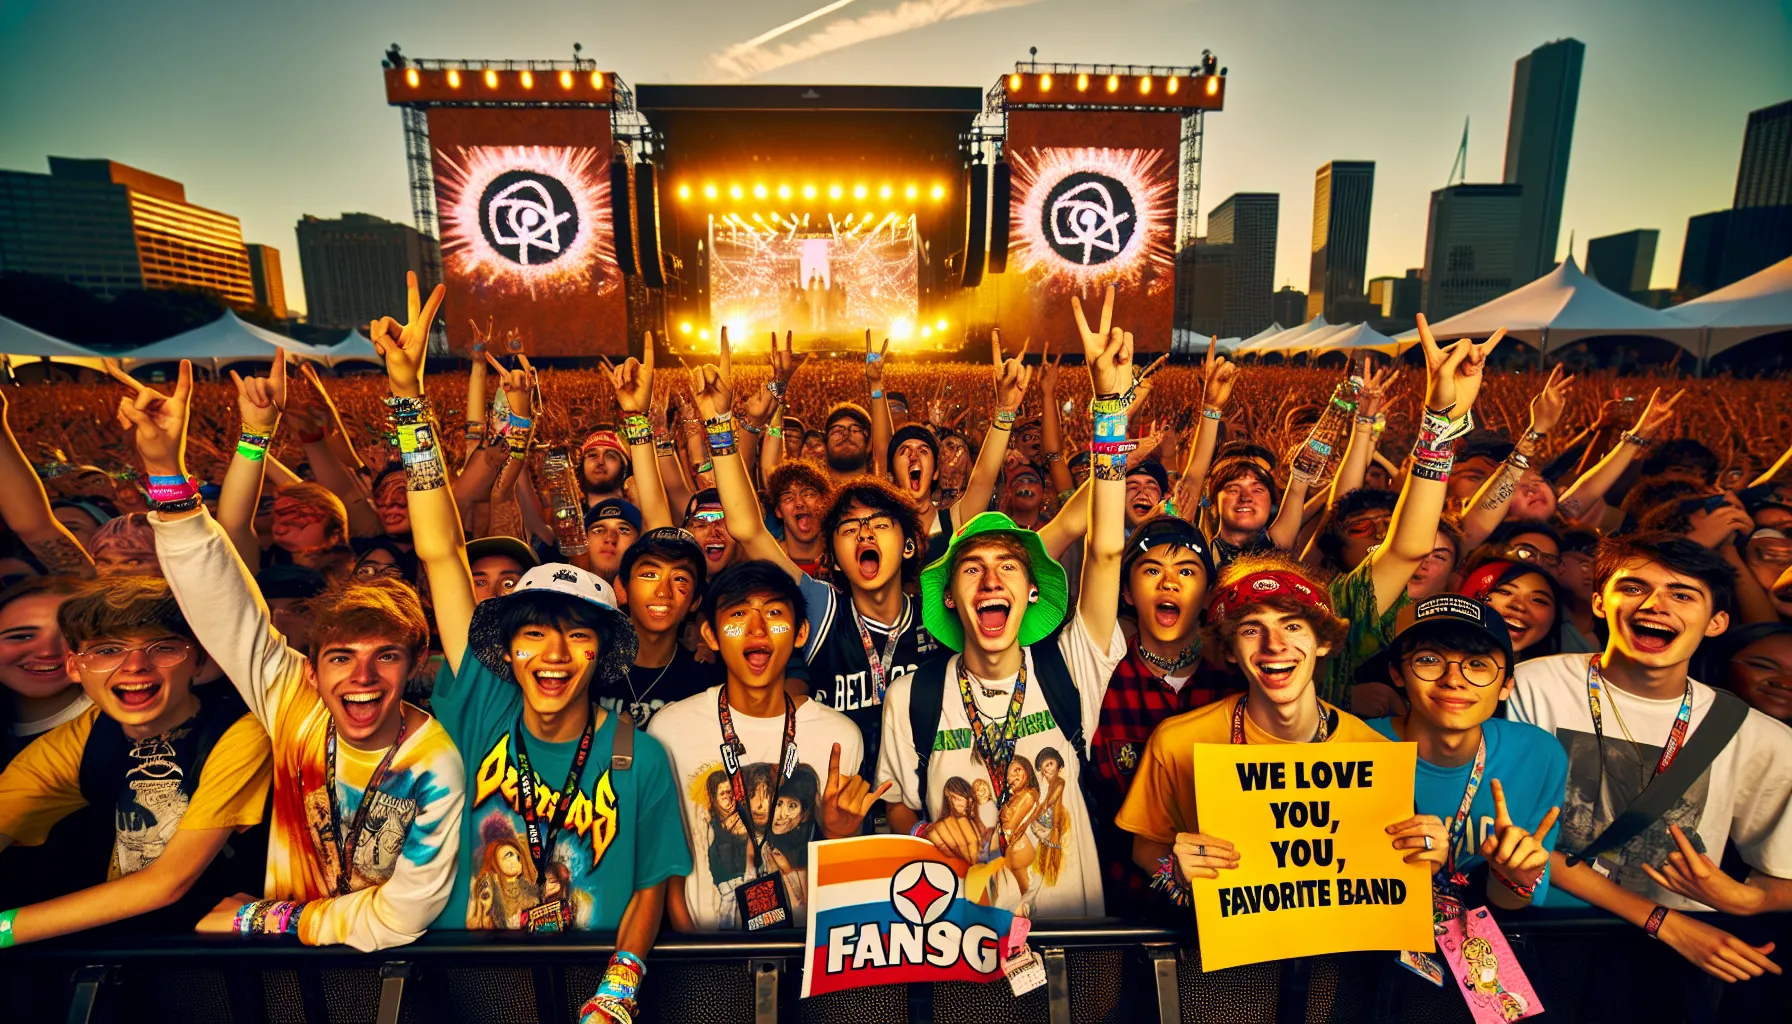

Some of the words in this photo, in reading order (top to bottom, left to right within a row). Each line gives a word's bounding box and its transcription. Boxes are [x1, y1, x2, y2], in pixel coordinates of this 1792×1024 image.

[1236, 762, 1286, 791] WE
[1295, 761, 1373, 789] LOVE
[1269, 801, 1340, 834] YOU,
[1270, 839, 1346, 873] YOU,
[1218, 879, 1331, 918] FAVORITE
[1337, 878, 1407, 905] BAND
